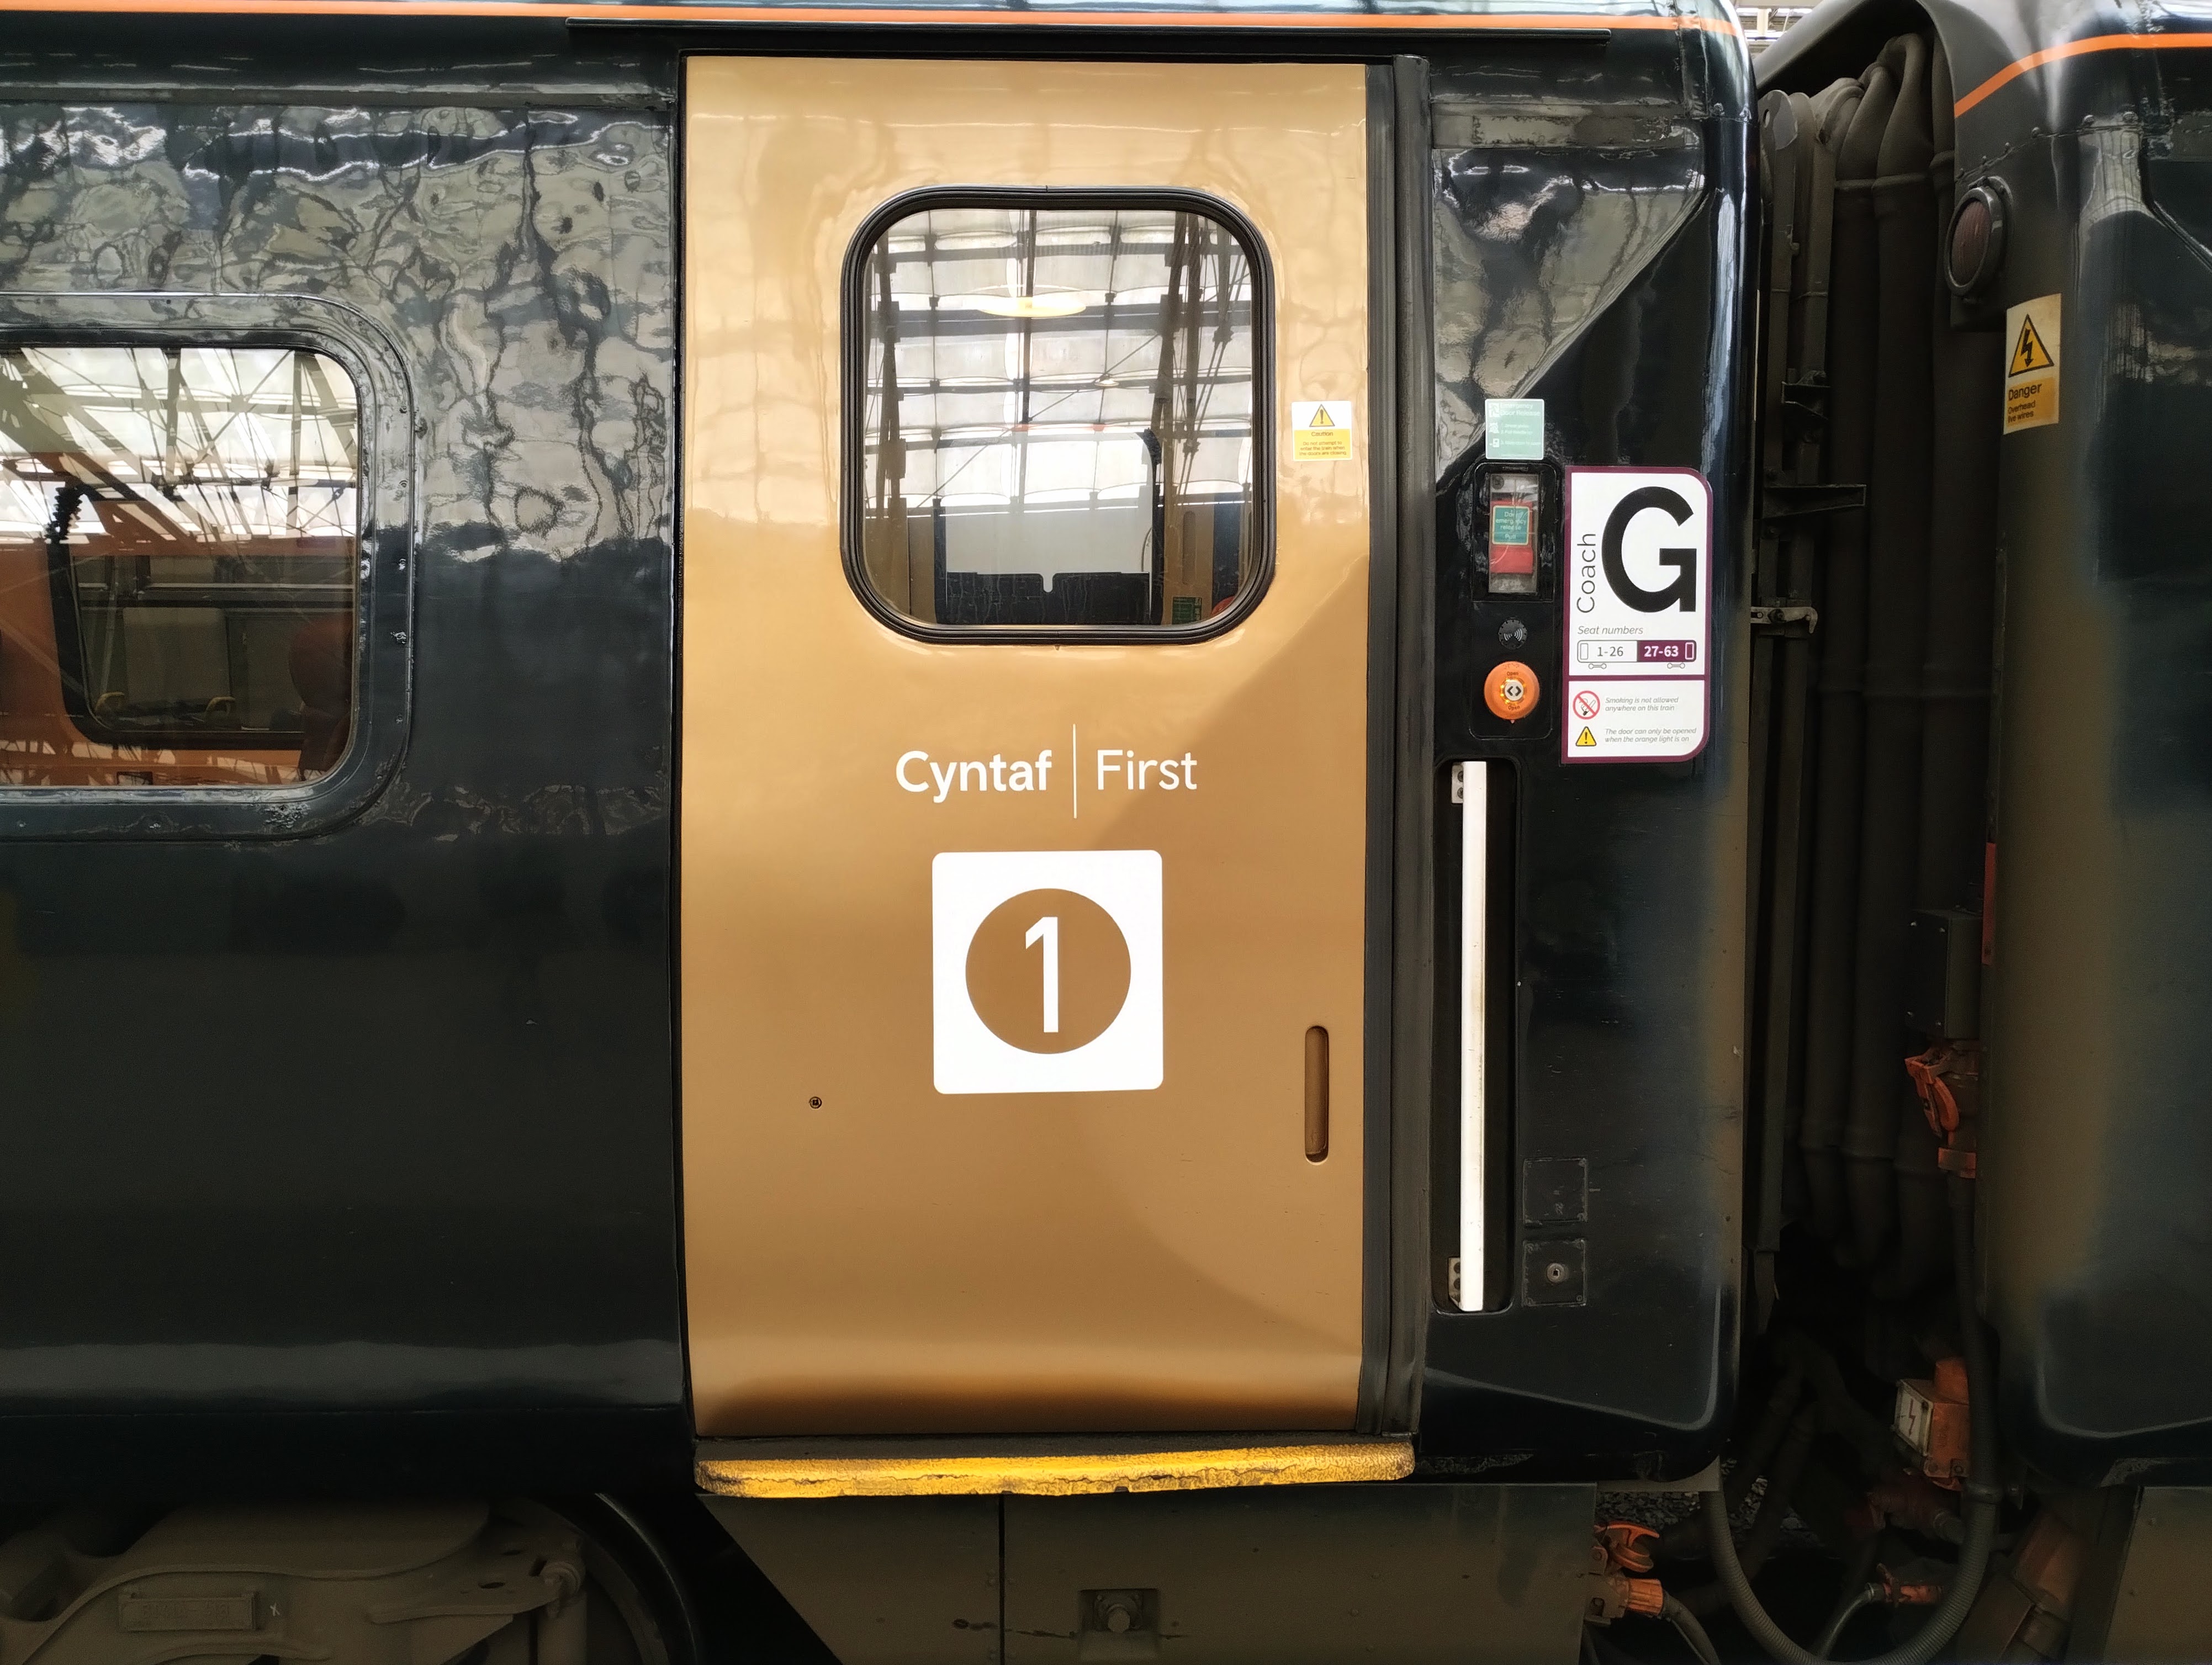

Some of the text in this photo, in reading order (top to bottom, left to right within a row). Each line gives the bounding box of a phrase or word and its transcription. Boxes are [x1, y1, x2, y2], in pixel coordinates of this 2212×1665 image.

[2009, 383, 2042, 401] Danger
[2008, 400, 2036, 414] Overhead
[2008, 411, 2034, 423] live wires
[1576, 486, 1697, 613] Coach G
[1578, 625, 1643, 634] Seat numbers
[1596, 645, 1679, 657] 1-26 27-63
[896, 749, 1198, 804] Cyntaf First
[1025, 916, 1059, 1033] 1
